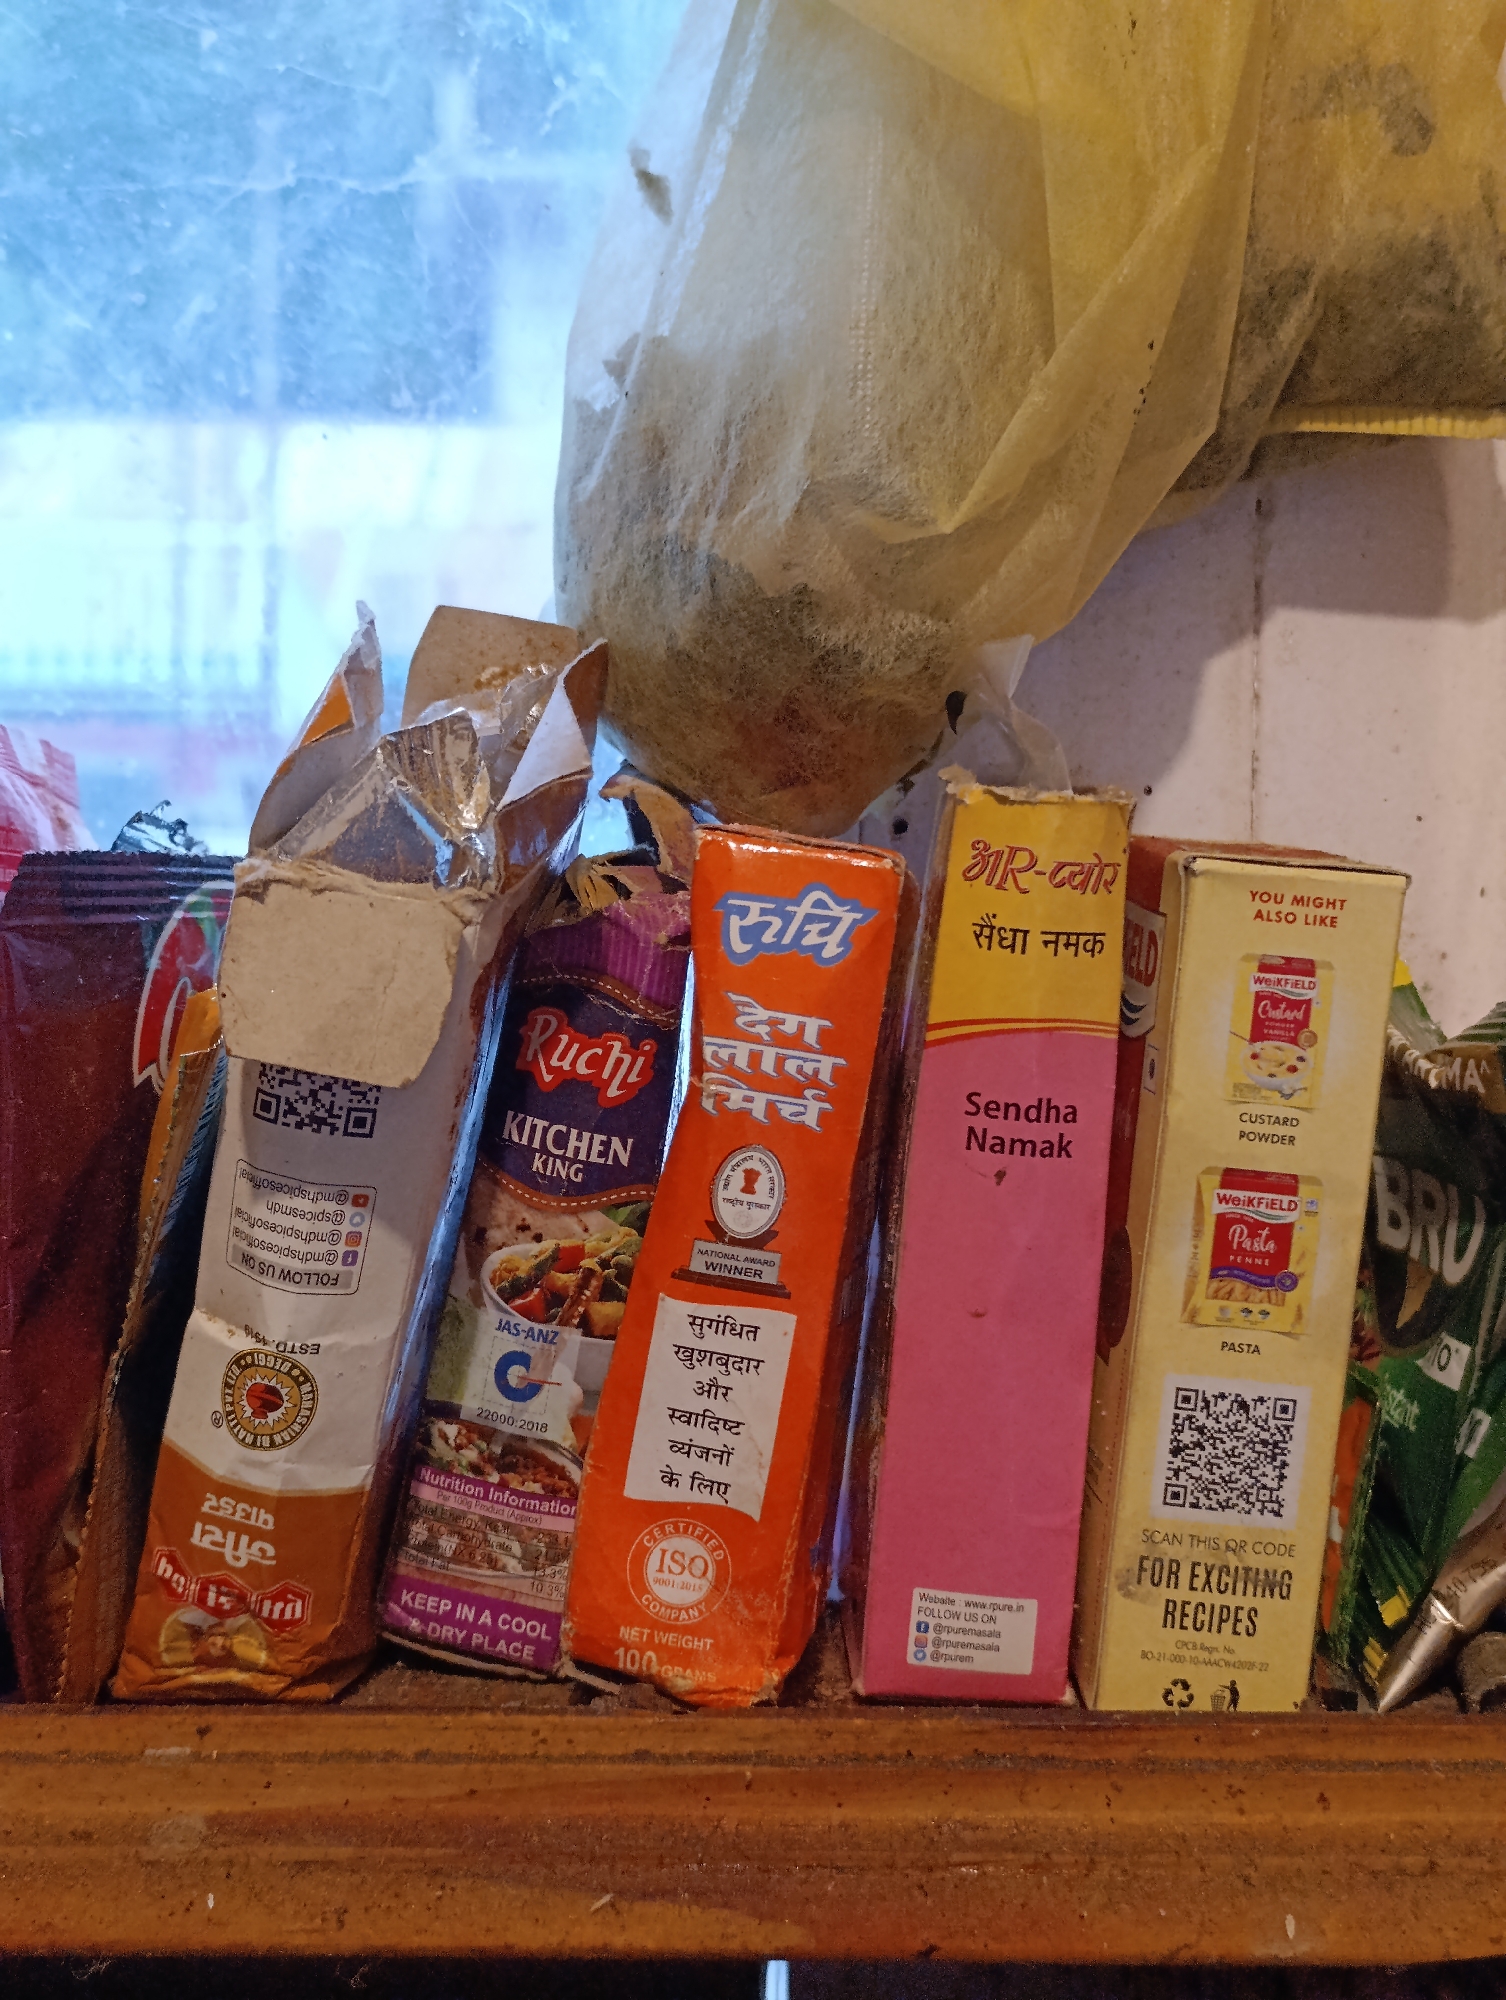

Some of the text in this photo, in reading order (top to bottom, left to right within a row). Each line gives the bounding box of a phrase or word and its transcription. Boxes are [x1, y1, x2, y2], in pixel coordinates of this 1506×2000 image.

[1249, 890, 1347, 911] YOU MIGHT
[1253, 908, 1338, 929] ALSO LIKE
[1040, 929, 1106, 959] नमक
[1258, 1000, 1307, 1021] Custard
[527, 1014, 651, 1098] Ruchi
[703, 1036, 848, 1087] लाल
[701, 1072, 834, 1132] मिर्च
[964, 1091, 1078, 1124] Sendha
[1239, 1112, 1300, 1128] CUSTARD
[502, 1110, 633, 1167] KITCHEN
[965, 1125, 1073, 1159] Namak
[1239, 1130, 1296, 1146] POWDER
[532, 1152, 584, 1183] KING
[239, 1167, 349, 1206] @mdhspicesofficial
[234, 1205, 342, 1246] @mdhspicesofficial
[266, 1199, 346, 1226] @spicesmdh
[1372, 1155, 1486, 1286] BRU
[231, 1225, 339, 1266] @mdhspicesofficial
[1228, 1224, 1277, 1254] Pasta
[240, 1251, 340, 1286] FOLLOW US ON
[697, 1248, 776, 1268] NATIONAL AWARD
[704, 1260, 763, 1279] WINNER
[1229, 1255, 1270, 1266] PENNE
[495, 1318, 560, 1345] JAS-ANZ
[687, 1313, 761, 1342] सुगंधित
[272, 1339, 321, 1355] ESTD.
[672, 1343, 764, 1376] खुशबुदार
[1220, 1341, 1261, 1355] PASTA
[253, 1352, 292, 1373] DEGGI
[692, 1377, 733, 1402] और
[476, 1406, 548, 1433] 22000:2018
[666, 1406, 745, 1436] स्वादिष्ट
[667, 1438, 735, 1467] व्यंजनों
[420, 1466, 484, 1498] Nutrition
[659, 1464, 731, 1504] के लिए
[200, 1492, 276, 1530] पाउडर
[474, 1498, 506, 1517] Product
[190, 1521, 277, 1568] जीरा
[643, 1522, 725, 1561] CERTIFIED
[1141, 1529, 1297, 1557] SCAN THIS QR CODE
[655, 1547, 709, 1579] ISO
[1136, 1555, 1293, 1600] FOR EXCITING
[401, 1588, 552, 1641] KEEP IN A COOL
[641, 1594, 707, 1621] COMPANY
[917, 1606, 997, 1625] FOLLOW US ON
[918, 1592, 956, 1606] Website
[964, 1600, 1025, 1613] www.rpure.in
[1162, 1598, 1259, 1637] RECIPES
[427, 1621, 467, 1645] DRY
[471, 1632, 536, 1661] PLACE
[619, 1625, 714, 1650] NET WEIGHT
[931, 1636, 1000, 1652] @rpuremasala
[932, 1622, 1002, 1639] @rpuremasala
[614, 1647, 717, 1683] 100 GRAMS
[930, 1649, 974, 1664] @rpurem
